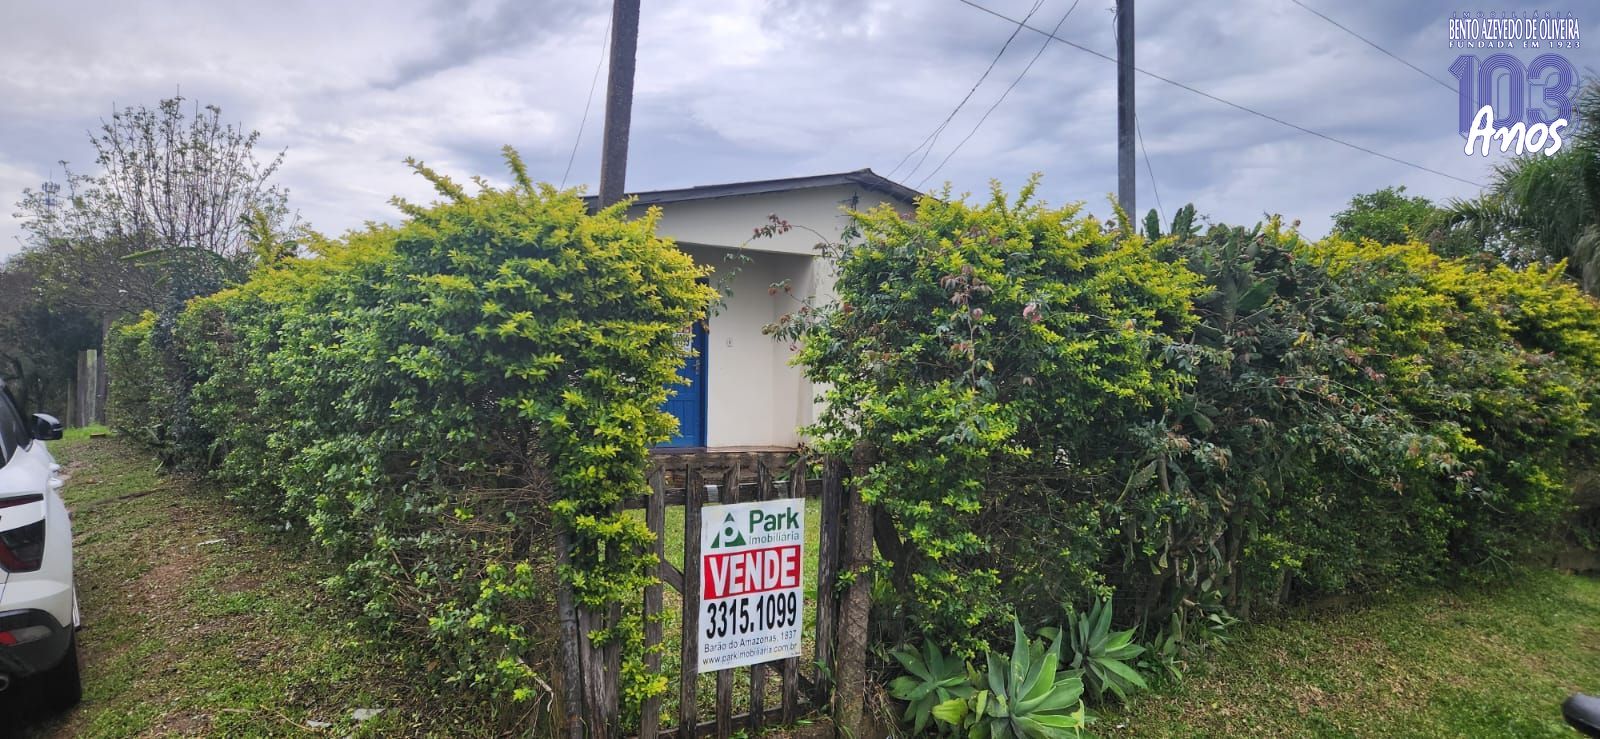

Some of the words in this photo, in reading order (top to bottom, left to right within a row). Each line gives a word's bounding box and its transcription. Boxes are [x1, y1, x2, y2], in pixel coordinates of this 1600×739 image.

[749, 507, 800, 534] Park
[709, 547, 797, 597] VENDE
[706, 591, 797, 639] 3315.1099
[704, 643, 727, 653] Barão
[728, 640, 739, 649] do
